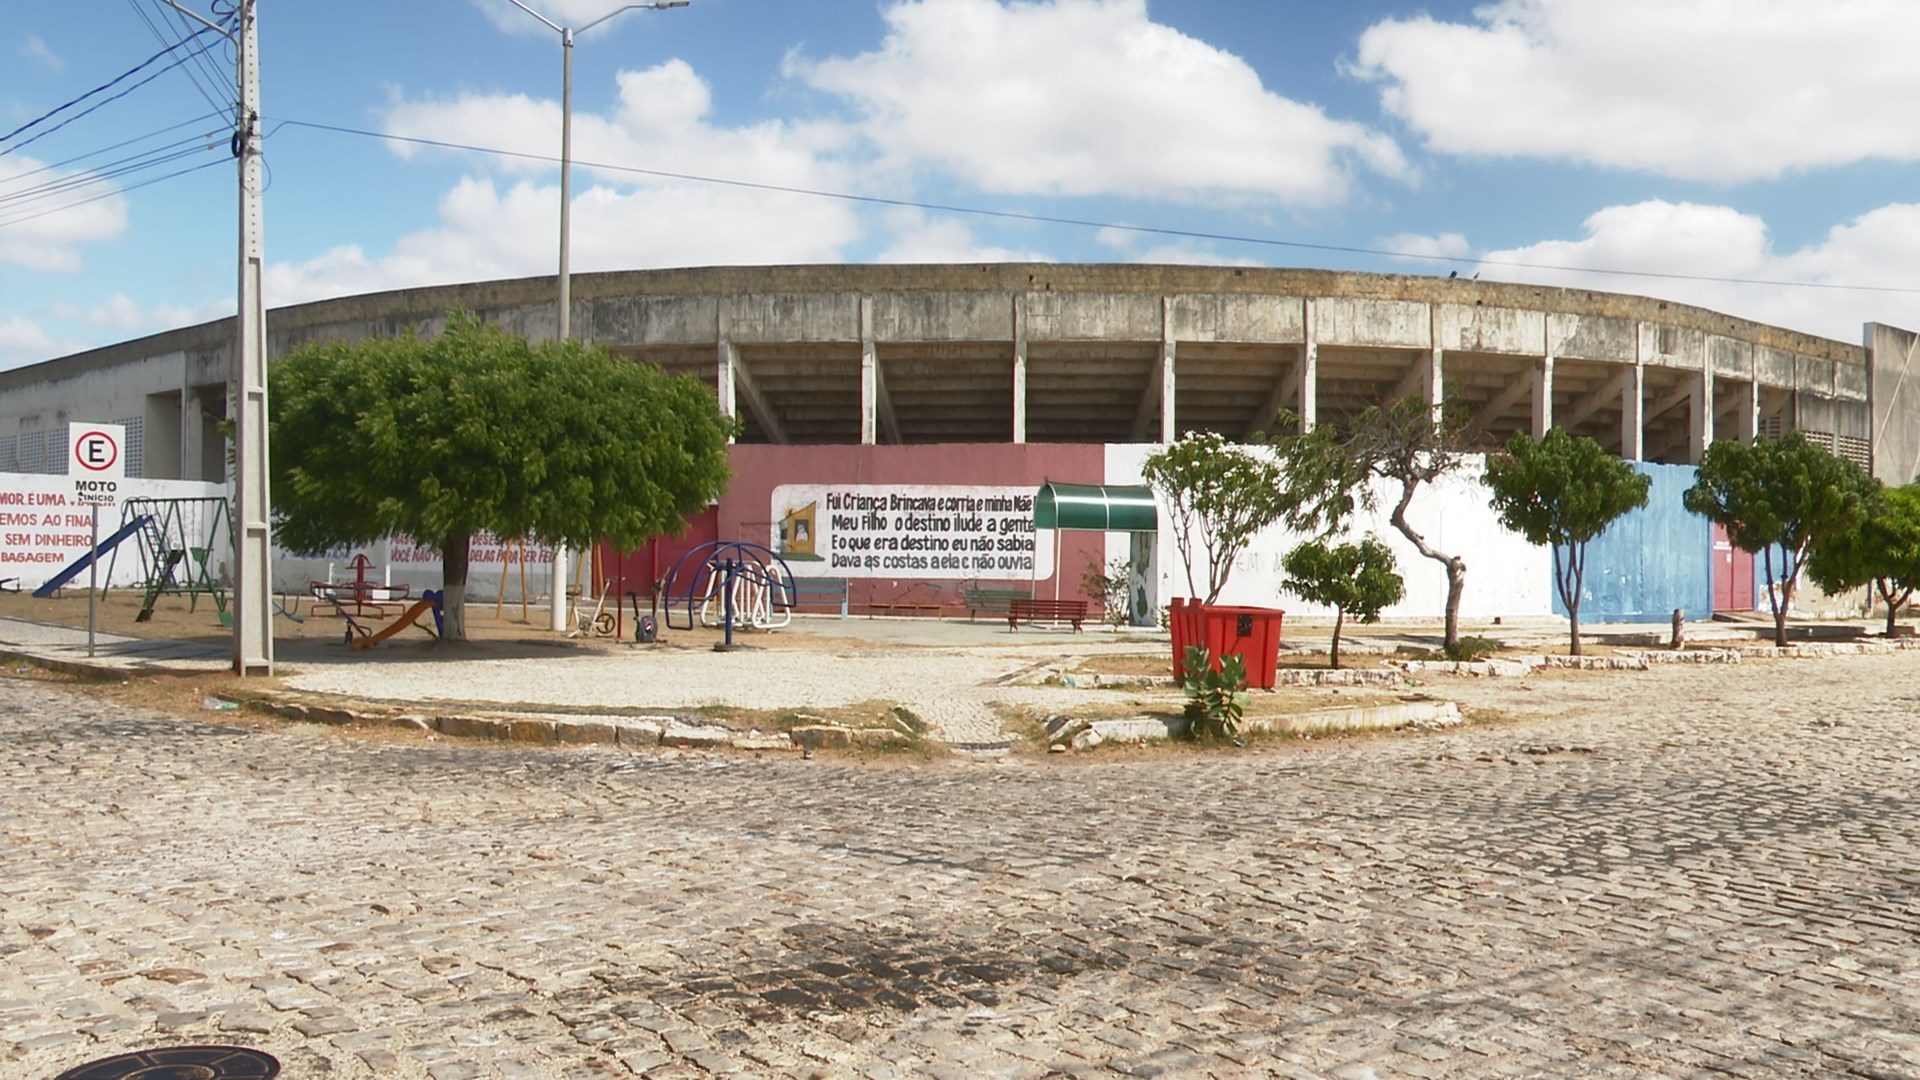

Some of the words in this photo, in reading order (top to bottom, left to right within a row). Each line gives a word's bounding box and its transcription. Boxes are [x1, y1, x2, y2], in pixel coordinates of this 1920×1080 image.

[88, 439, 105, 463] E
[75, 480, 117, 492] MOTO
[36, 494, 66, 506] UMA
[826, 493, 841, 510] Fui
[843, 493, 887, 511] Criança
[890, 493, 936, 511] Brincava
[985, 495, 1012, 512] minha
[42, 514, 61, 526] AO
[65, 515, 98, 527] FINA
[831, 514, 859, 530] Meu
[861, 512, 888, 531] Filho
[895, 517, 903, 531] o
[904, 512, 951, 531] destino
[953, 512, 983, 532] ilude
[986, 518, 996, 532] a
[999, 516, 1035, 535] gente
[5, 533, 31, 546] SEM
[35, 534, 93, 547] DINHEIRO
[831, 534, 838, 549] E
[838, 537, 847, 549] o
[848, 537, 871, 552] que
[873, 537, 898, 550] era
[900, 534, 949, 551] destino
[951, 538, 968, 551] eu
[970, 535, 995, 551] não
[996, 534, 1035, 551] sabia
[1, 552, 64, 563] BAGAGEM
[469, 550, 496, 562] DELAS
[831, 552, 861, 568] Dava
[864, 555, 880, 568] as
[883, 553, 928, 569] costas
[971, 554, 996, 569] não
[997, 552, 1032, 570] ouvia
